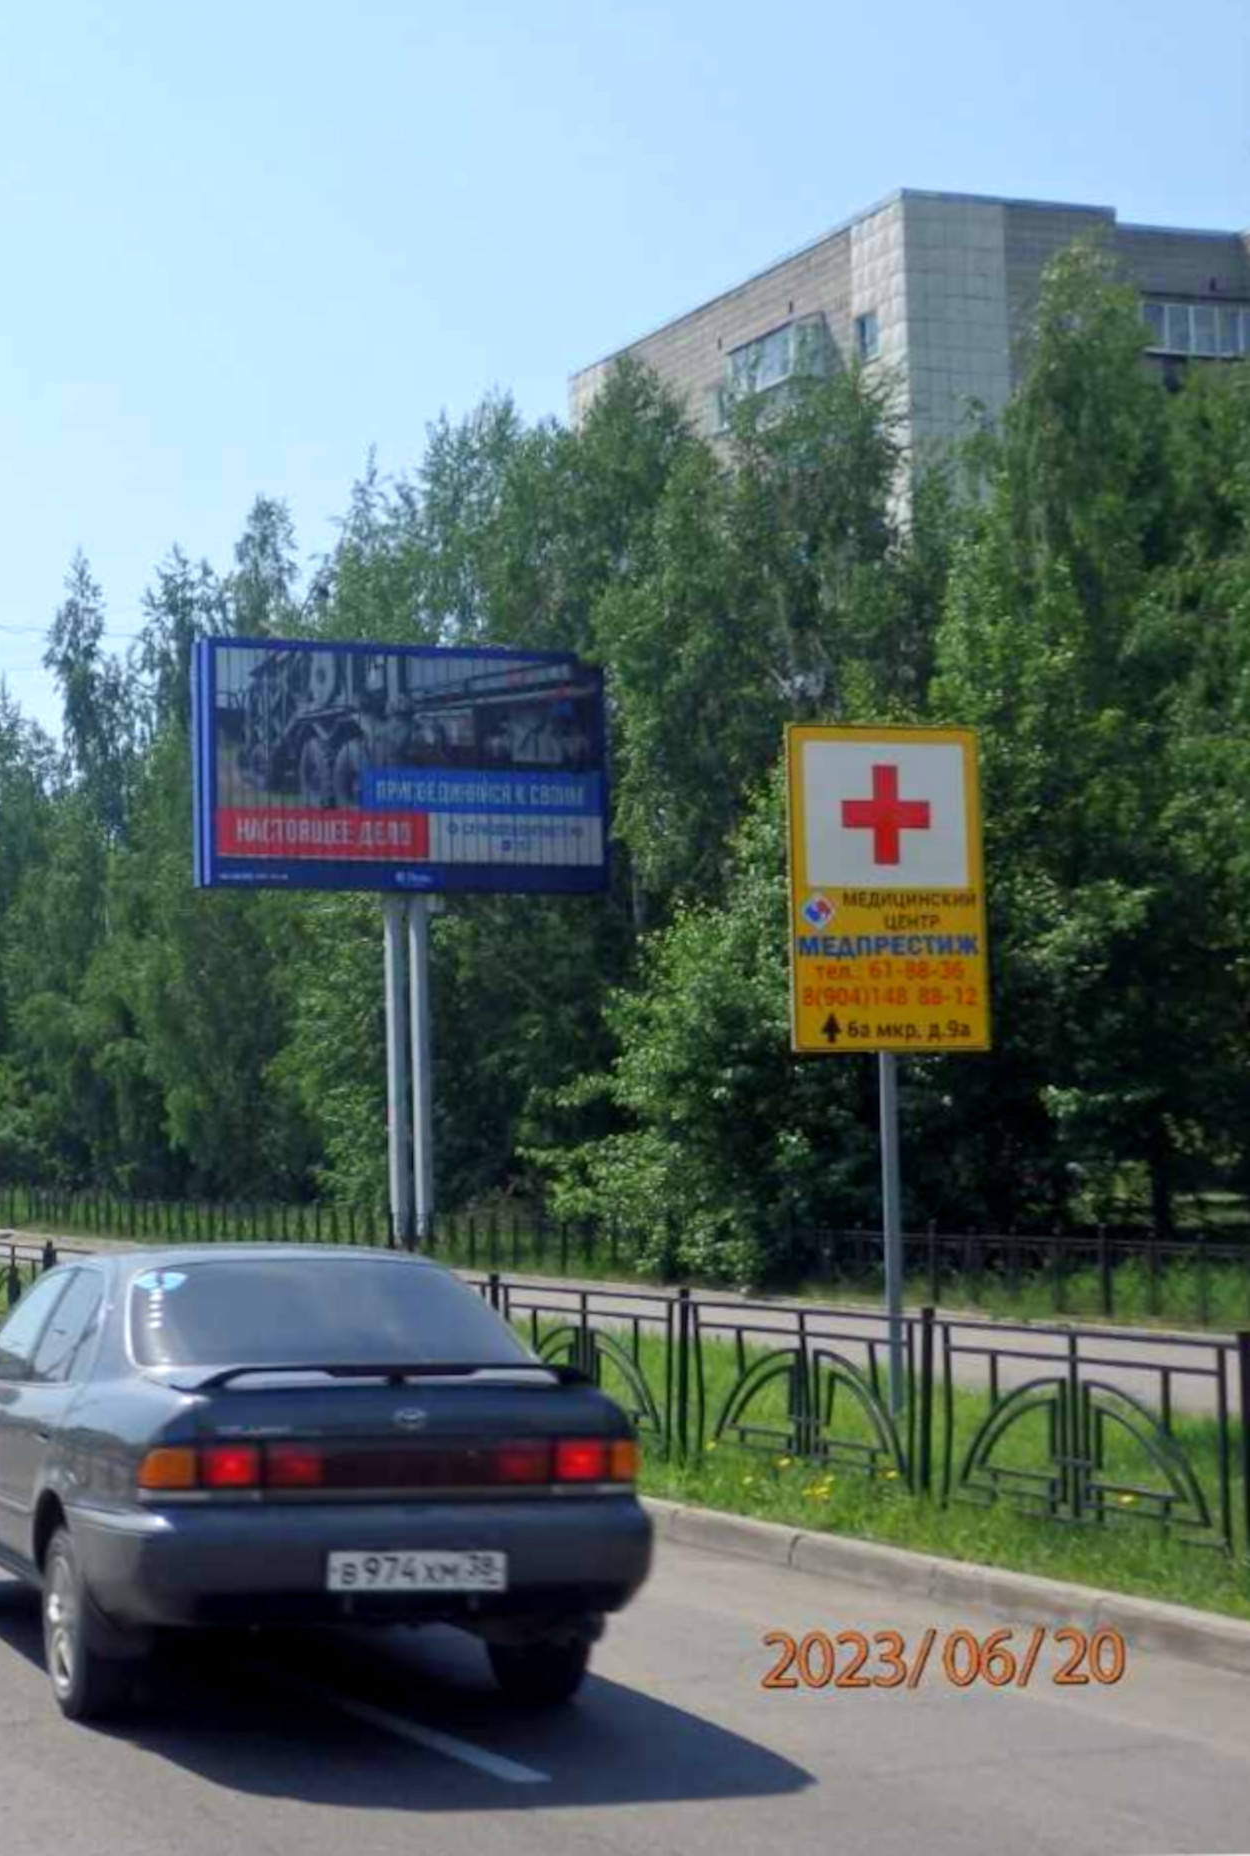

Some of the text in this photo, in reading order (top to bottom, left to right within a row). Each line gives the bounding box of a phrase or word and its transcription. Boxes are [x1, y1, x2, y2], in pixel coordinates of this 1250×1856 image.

[236, 818, 413, 848] НАСТОЯЩЕЕ ДЕЛО
[842, 891, 976, 910] МЕДИЦИНСКИЙ
[884, 914, 940, 931] ЦЕНТР
[798, 935, 979, 960] МЕДПРЕСТИЖ
